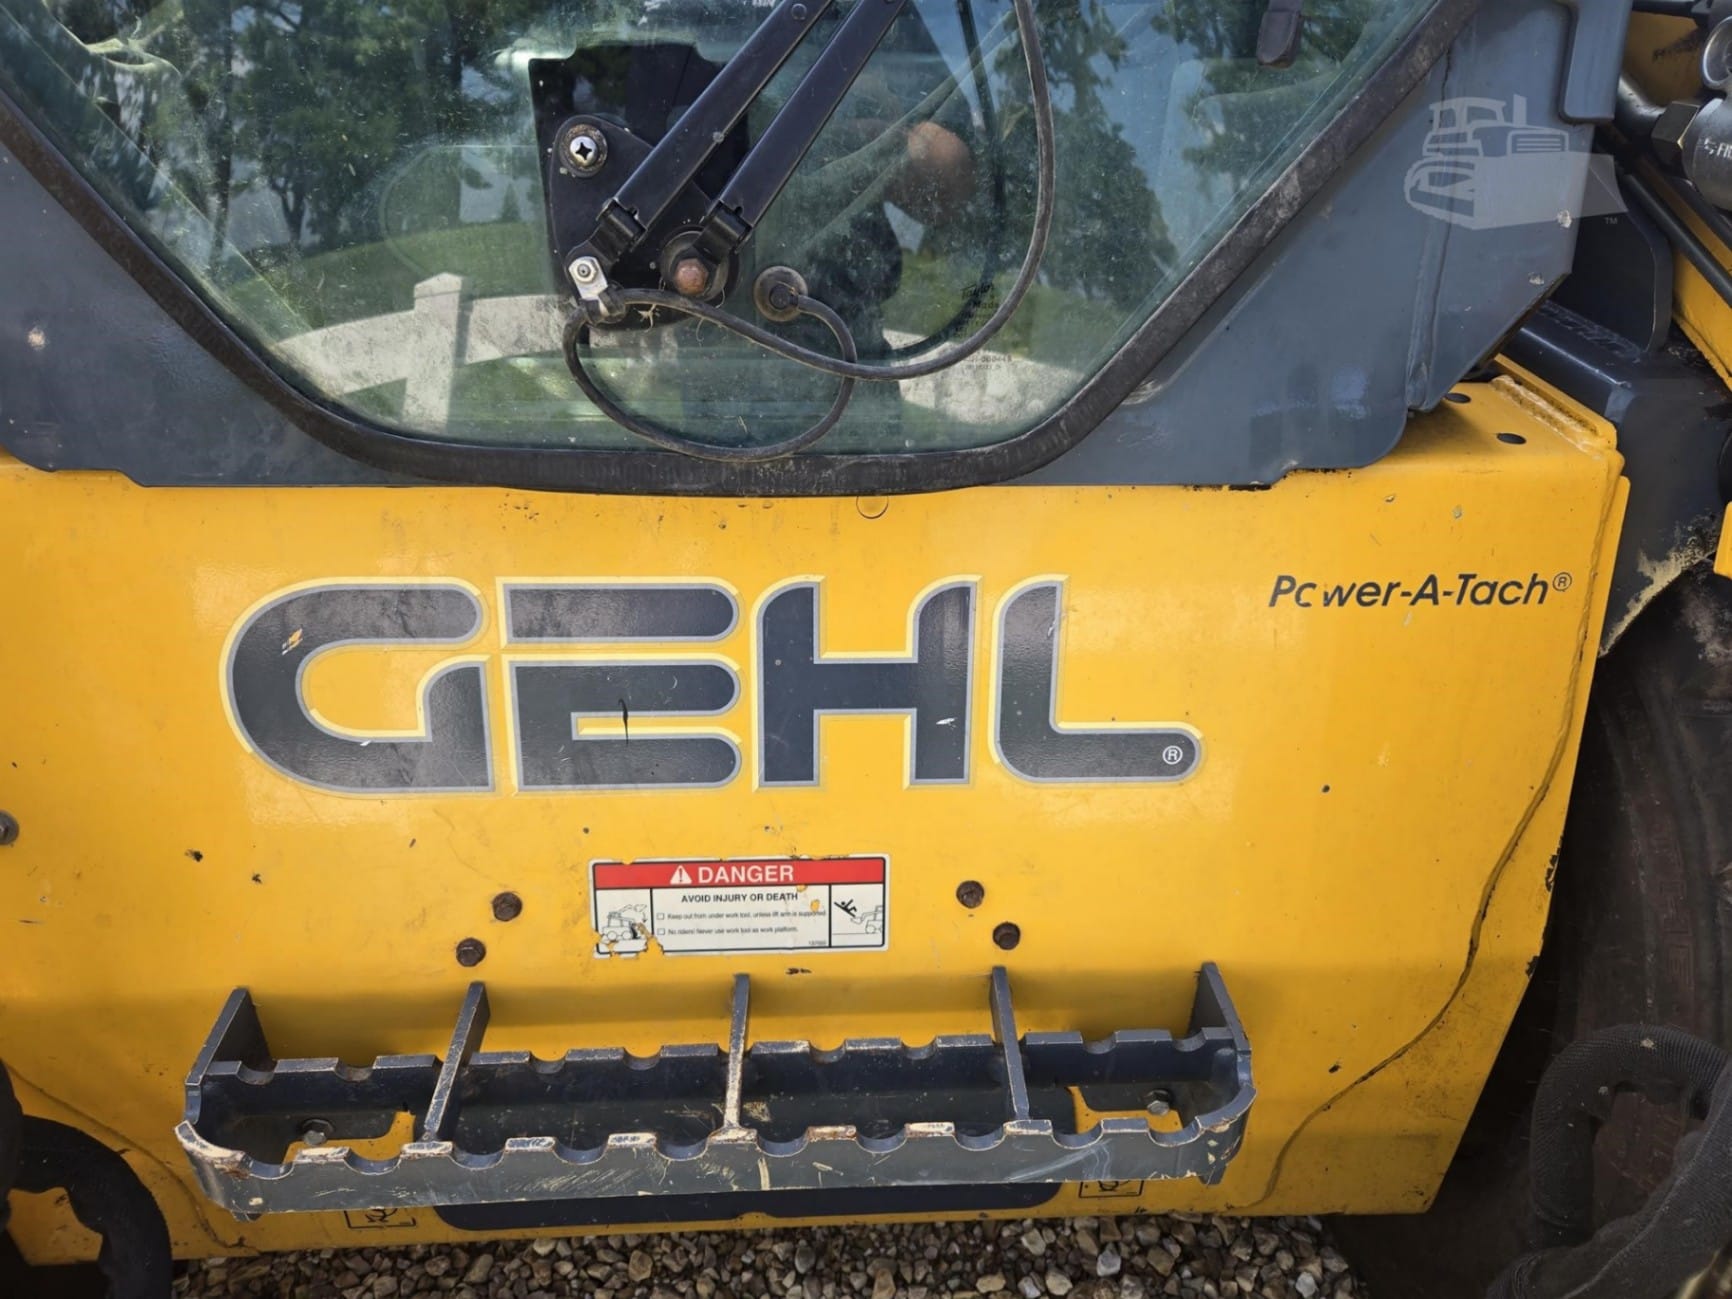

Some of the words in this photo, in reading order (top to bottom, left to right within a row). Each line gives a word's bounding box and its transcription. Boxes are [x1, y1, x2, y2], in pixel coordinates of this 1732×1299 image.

[221, 576, 1203, 794] GEHL
[698, 865, 794, 884] DANGER
[681, 894, 711, 903] AVOID
[713, 893, 747, 902] INJURY
[749, 893, 764, 901] OR
[766, 892, 798, 901] DEATH
